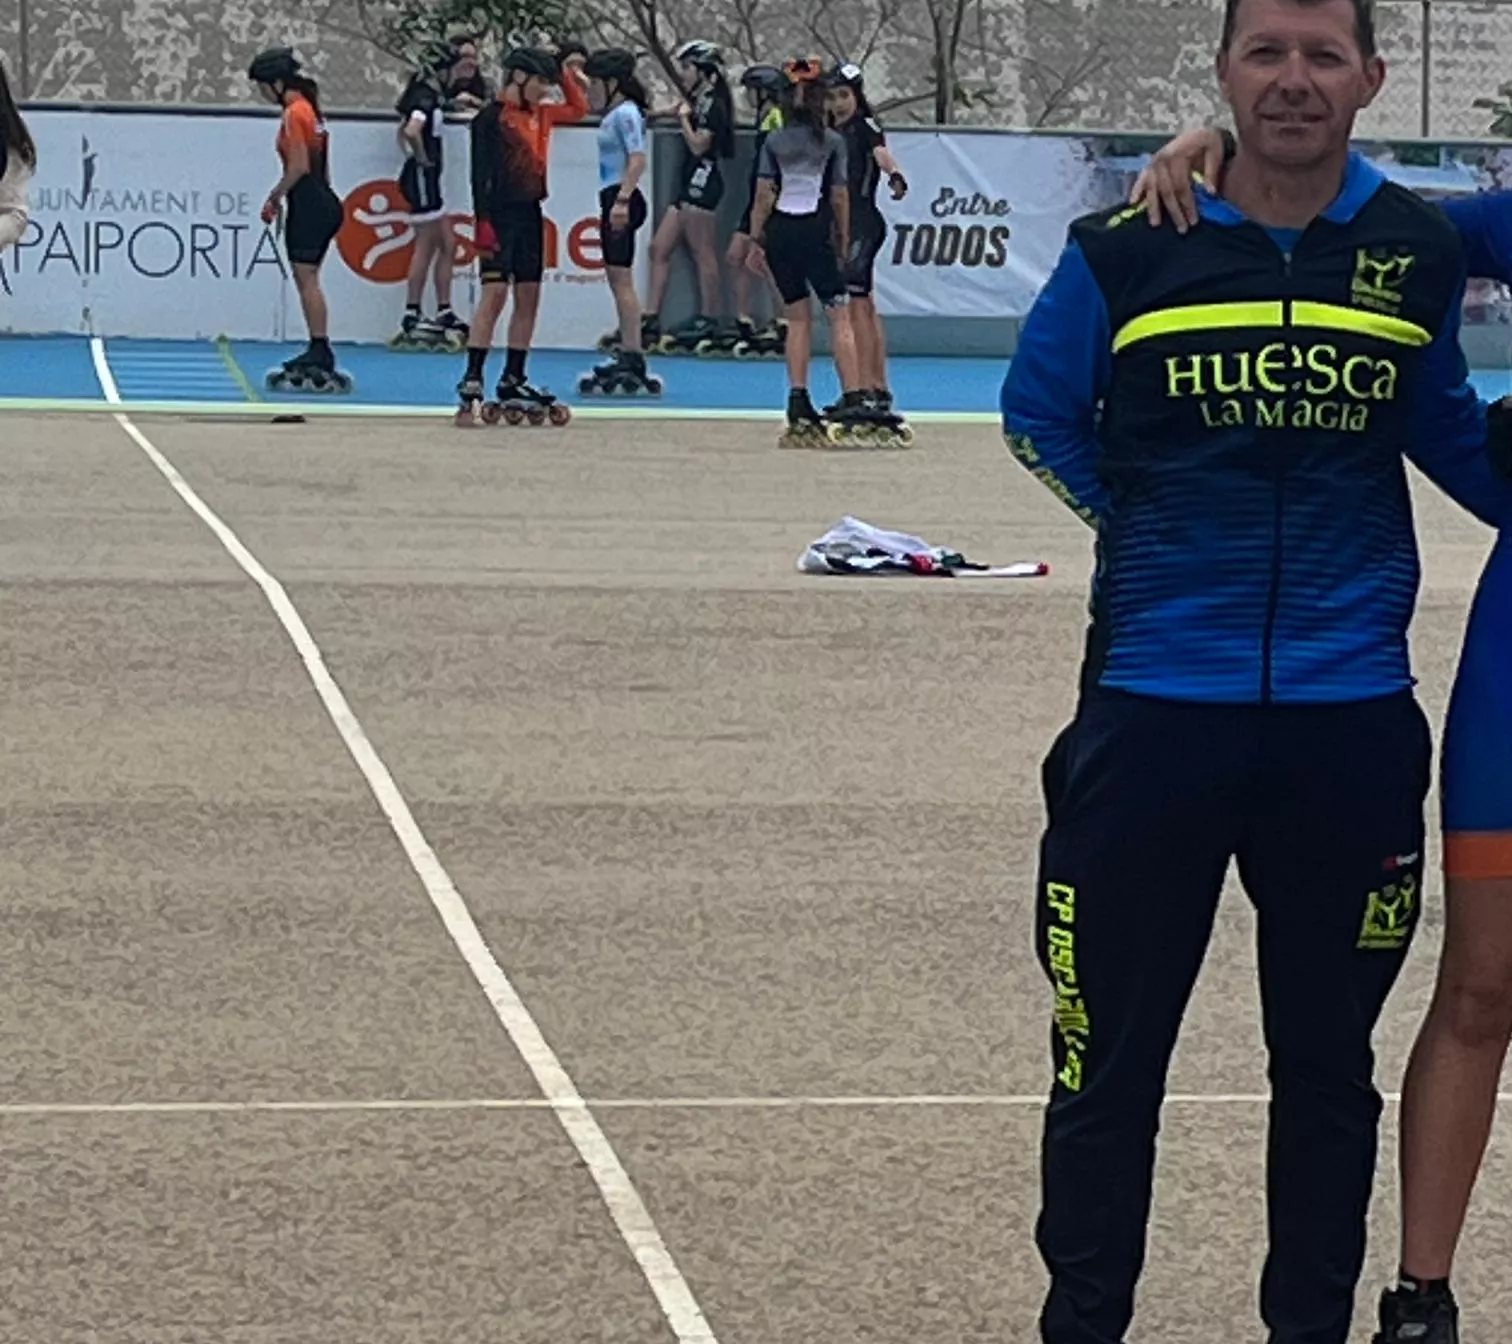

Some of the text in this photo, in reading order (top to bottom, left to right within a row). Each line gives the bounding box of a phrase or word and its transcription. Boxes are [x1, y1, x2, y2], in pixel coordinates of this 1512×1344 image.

[215, 192, 249, 215] DE
[930, 186, 1012, 218] Entre
[13, 219, 288, 280] PAIPORTA
[891, 223, 1011, 268] TODOS
